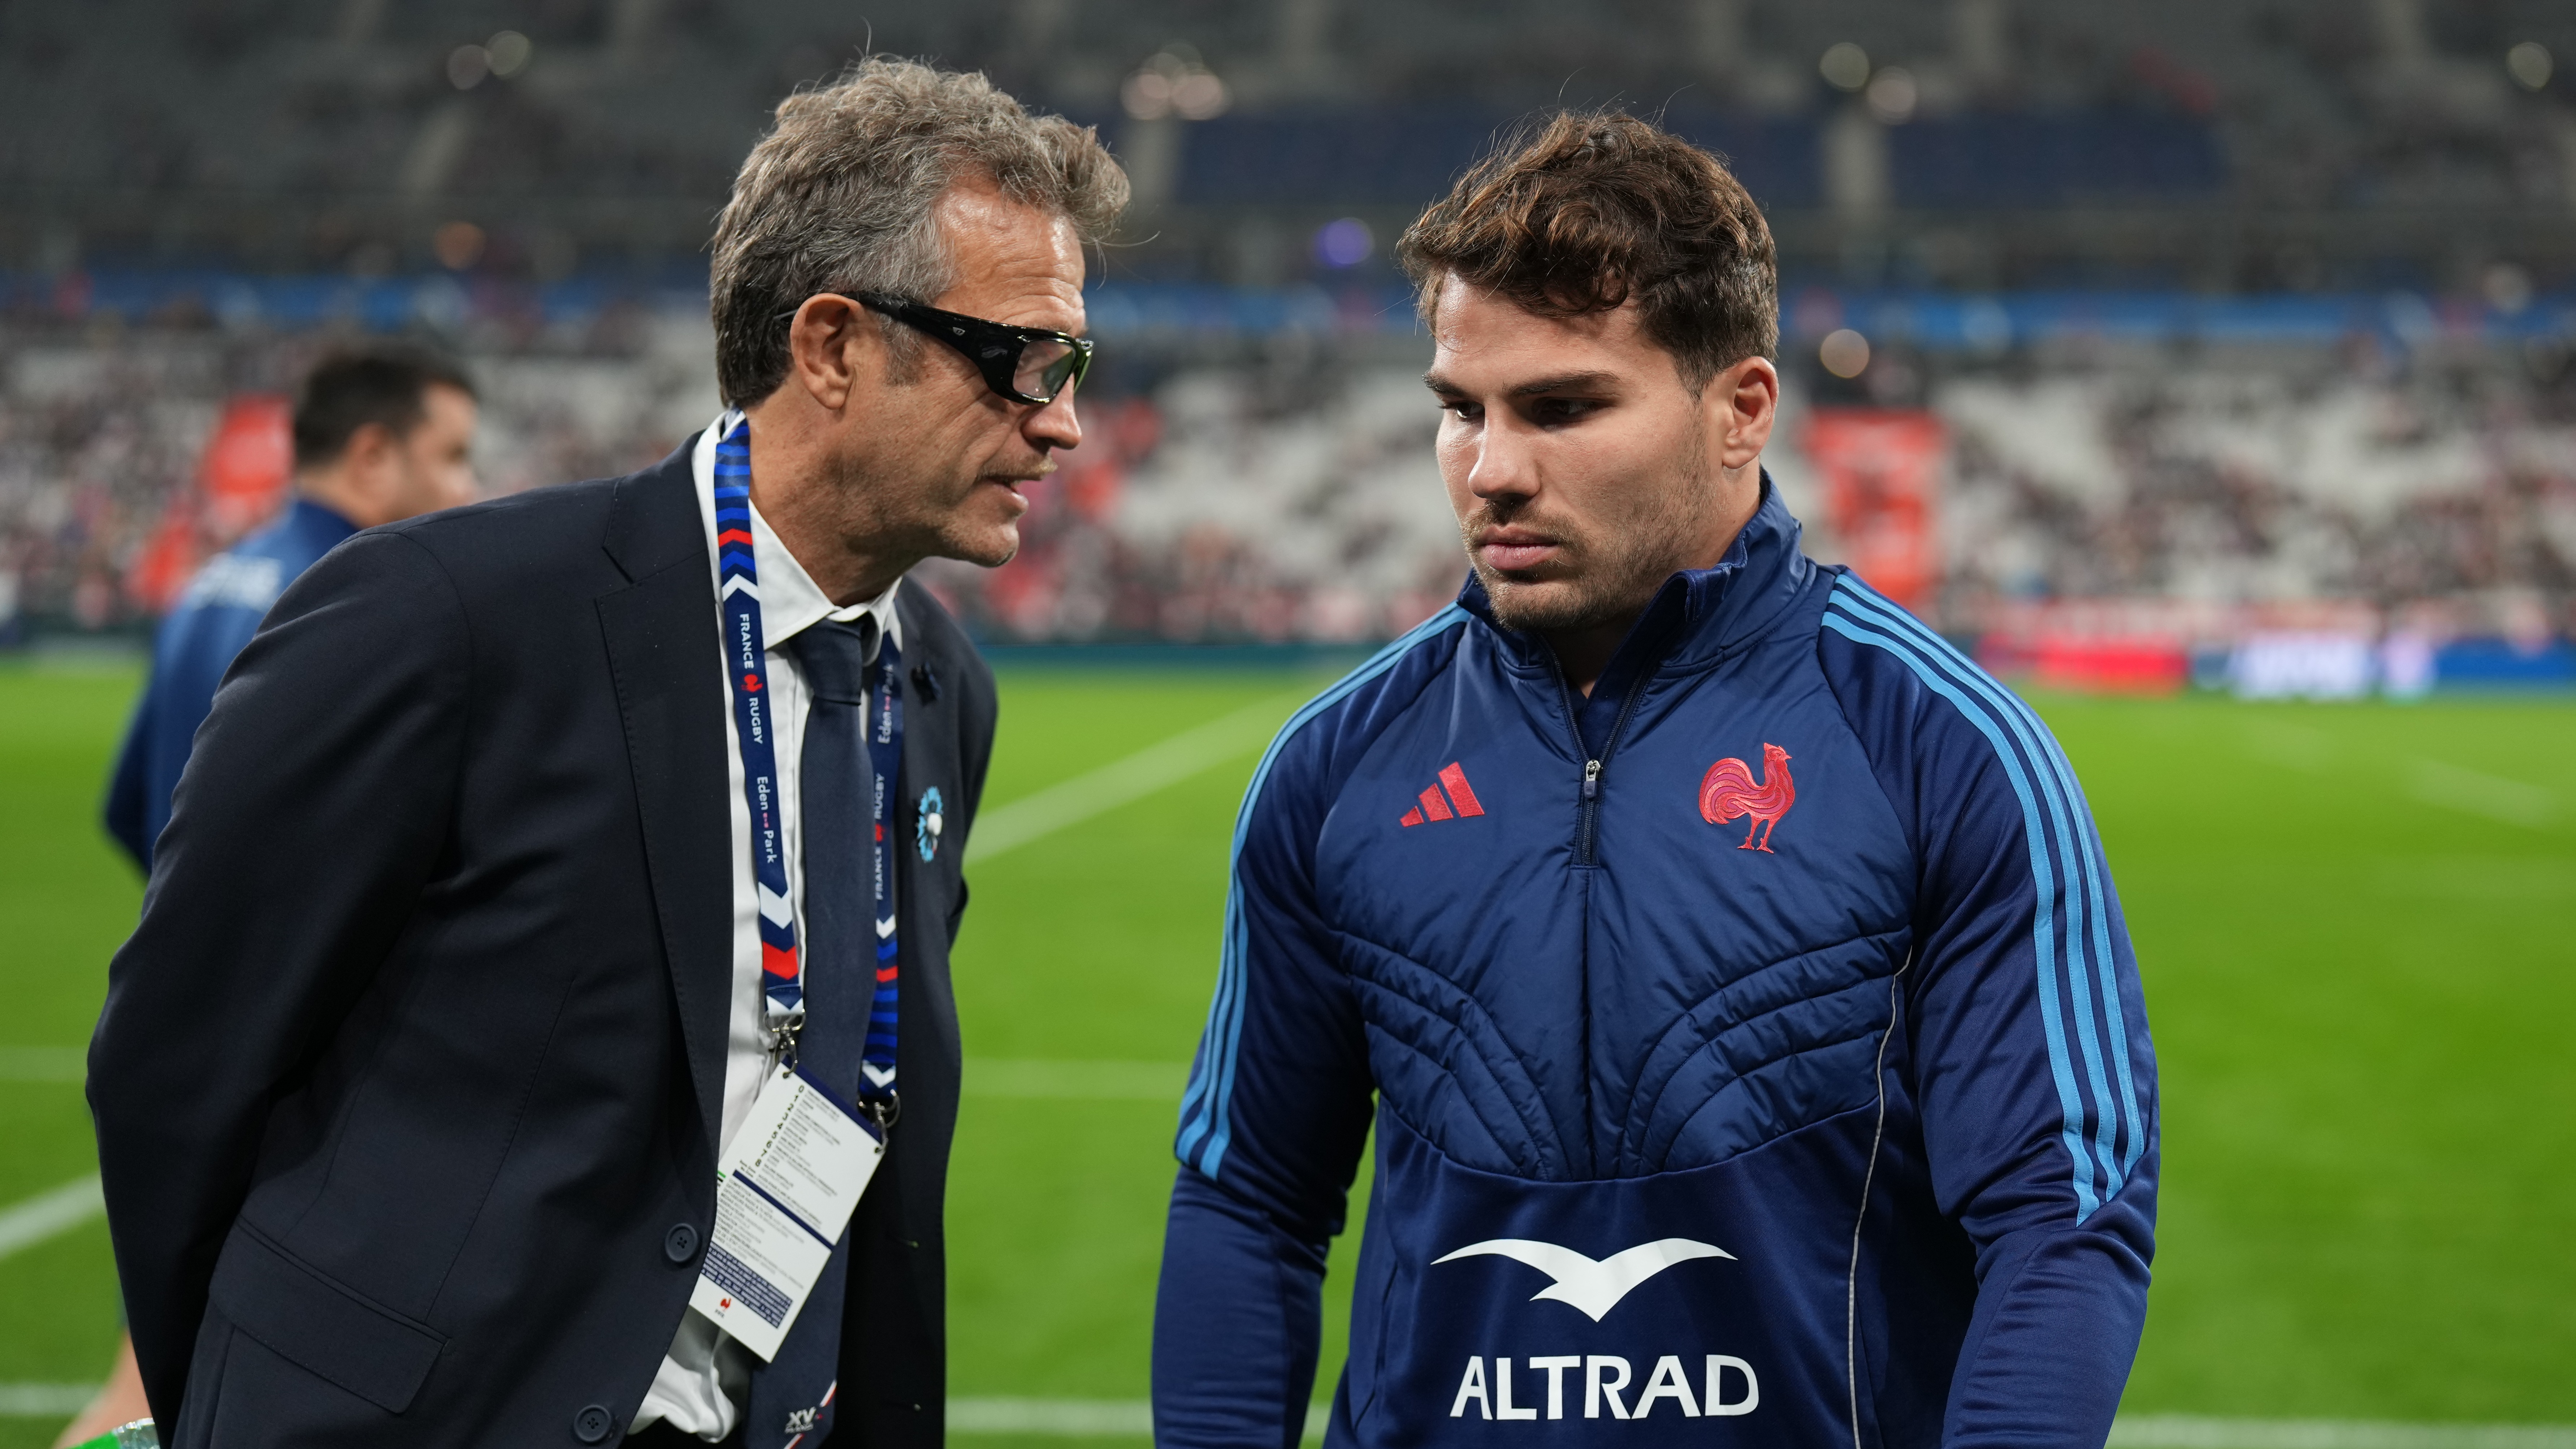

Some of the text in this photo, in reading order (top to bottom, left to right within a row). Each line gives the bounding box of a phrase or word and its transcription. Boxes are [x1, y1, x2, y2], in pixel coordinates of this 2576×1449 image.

[739, 613, 763, 744] FRANCE RUGBY
[878, 711, 892, 744] Eden
[757, 776, 775, 863] Eden Park
[874, 773, 884, 900] FRANCE RUGBY
[782, 1112, 788, 1120] 3
[787, 1103, 794, 1112] 2
[761, 1149, 767, 1157] 7
[1450, 1354, 1759, 1420] ALTRAD
[785, 1406, 817, 1427] XV
